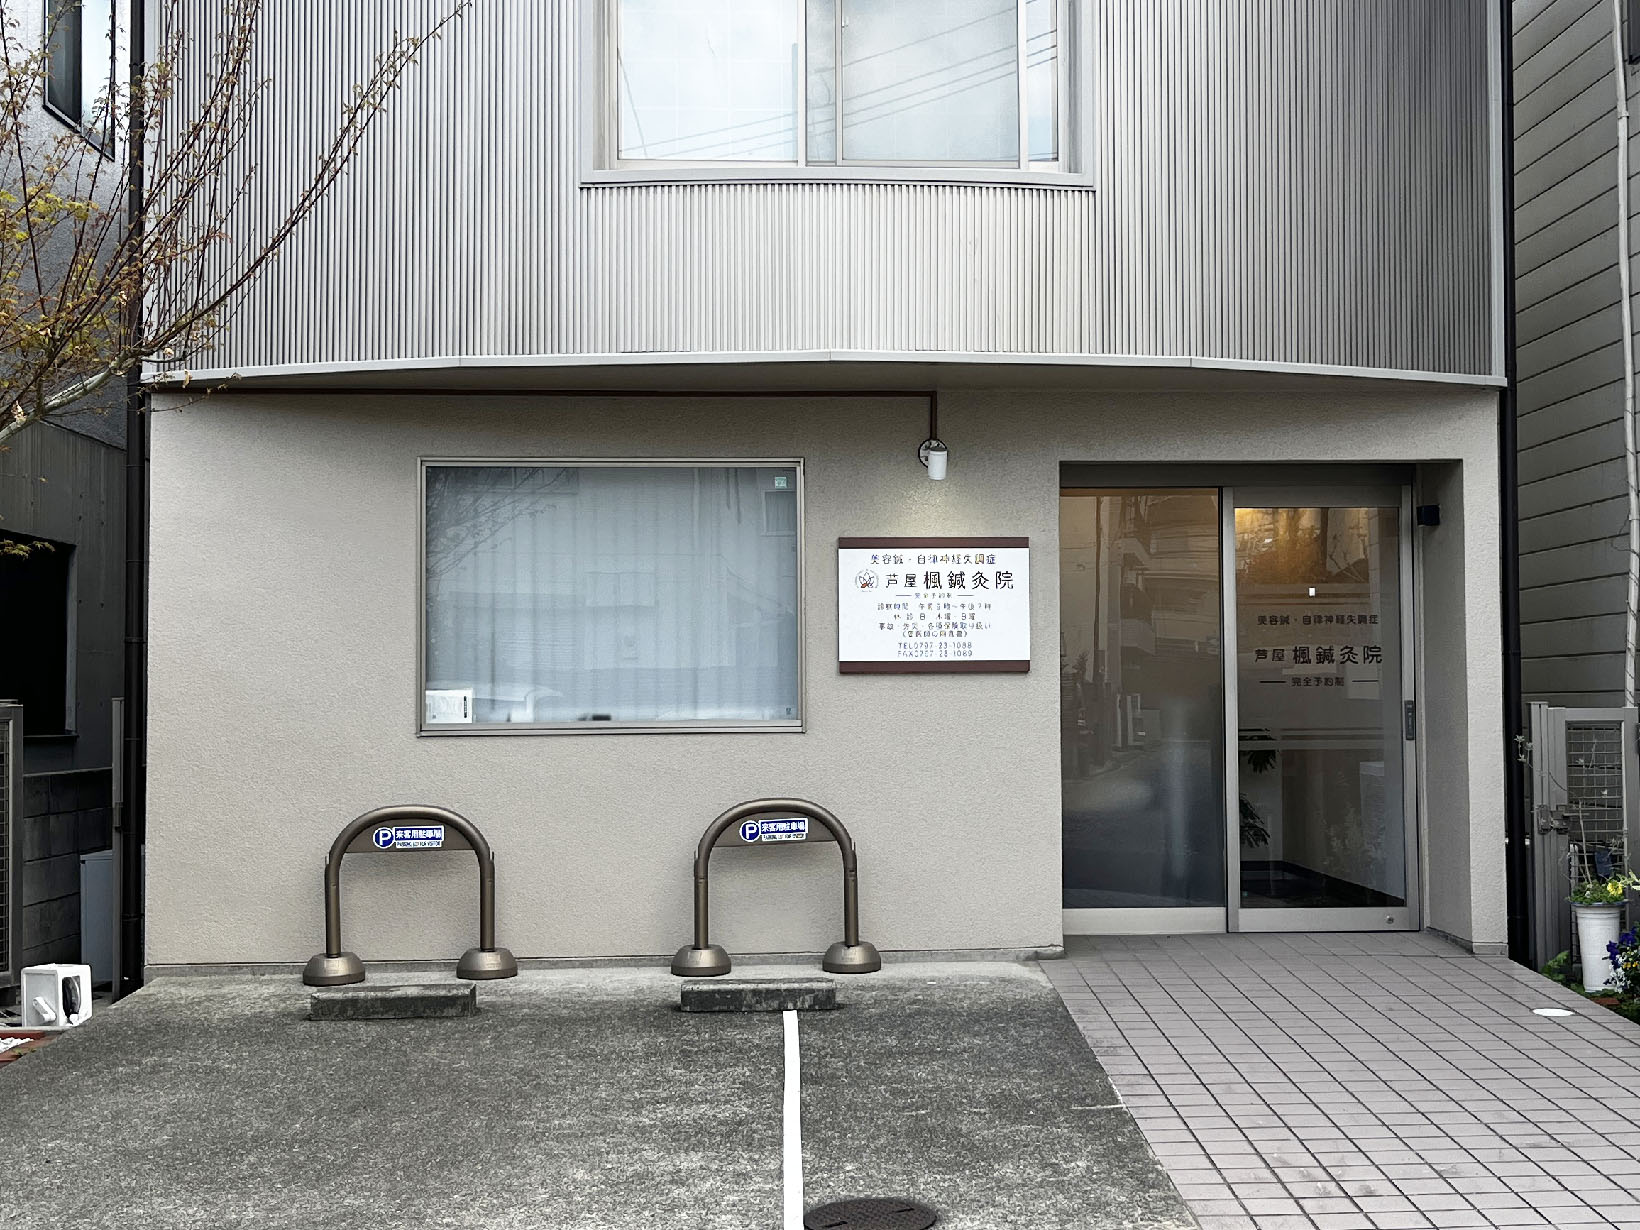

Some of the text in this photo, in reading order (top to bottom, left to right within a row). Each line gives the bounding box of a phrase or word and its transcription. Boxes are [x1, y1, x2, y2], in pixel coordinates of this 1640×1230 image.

[1257, 614, 1379, 625] 美容鍼・自律神経失調症
[1291, 677, 1345, 687] 完全予約制
[379, 830, 391, 845] P
[745, 824, 757, 839] P
